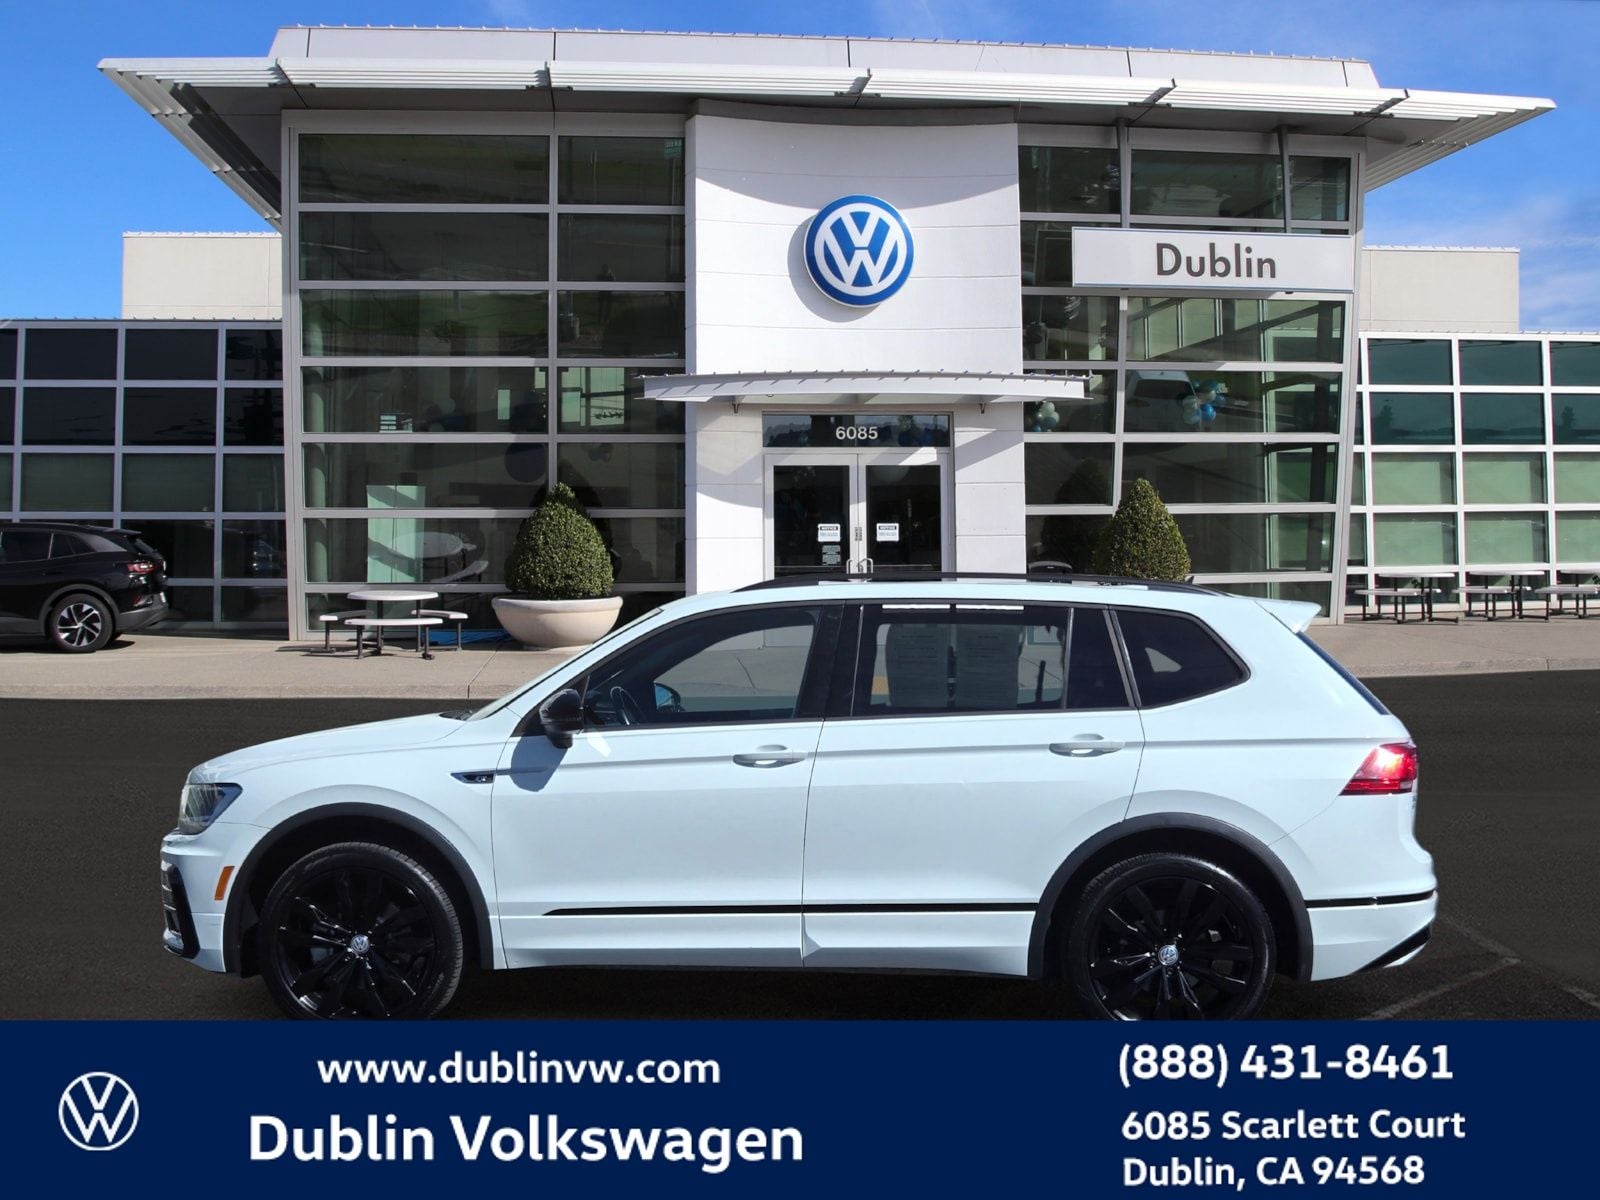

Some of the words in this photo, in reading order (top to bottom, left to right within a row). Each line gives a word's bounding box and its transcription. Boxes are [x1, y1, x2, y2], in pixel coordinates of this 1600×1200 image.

[814, 203, 906, 295] VW
[1156, 242, 1276, 278] Dublin
[835, 426, 879, 440] 6085
